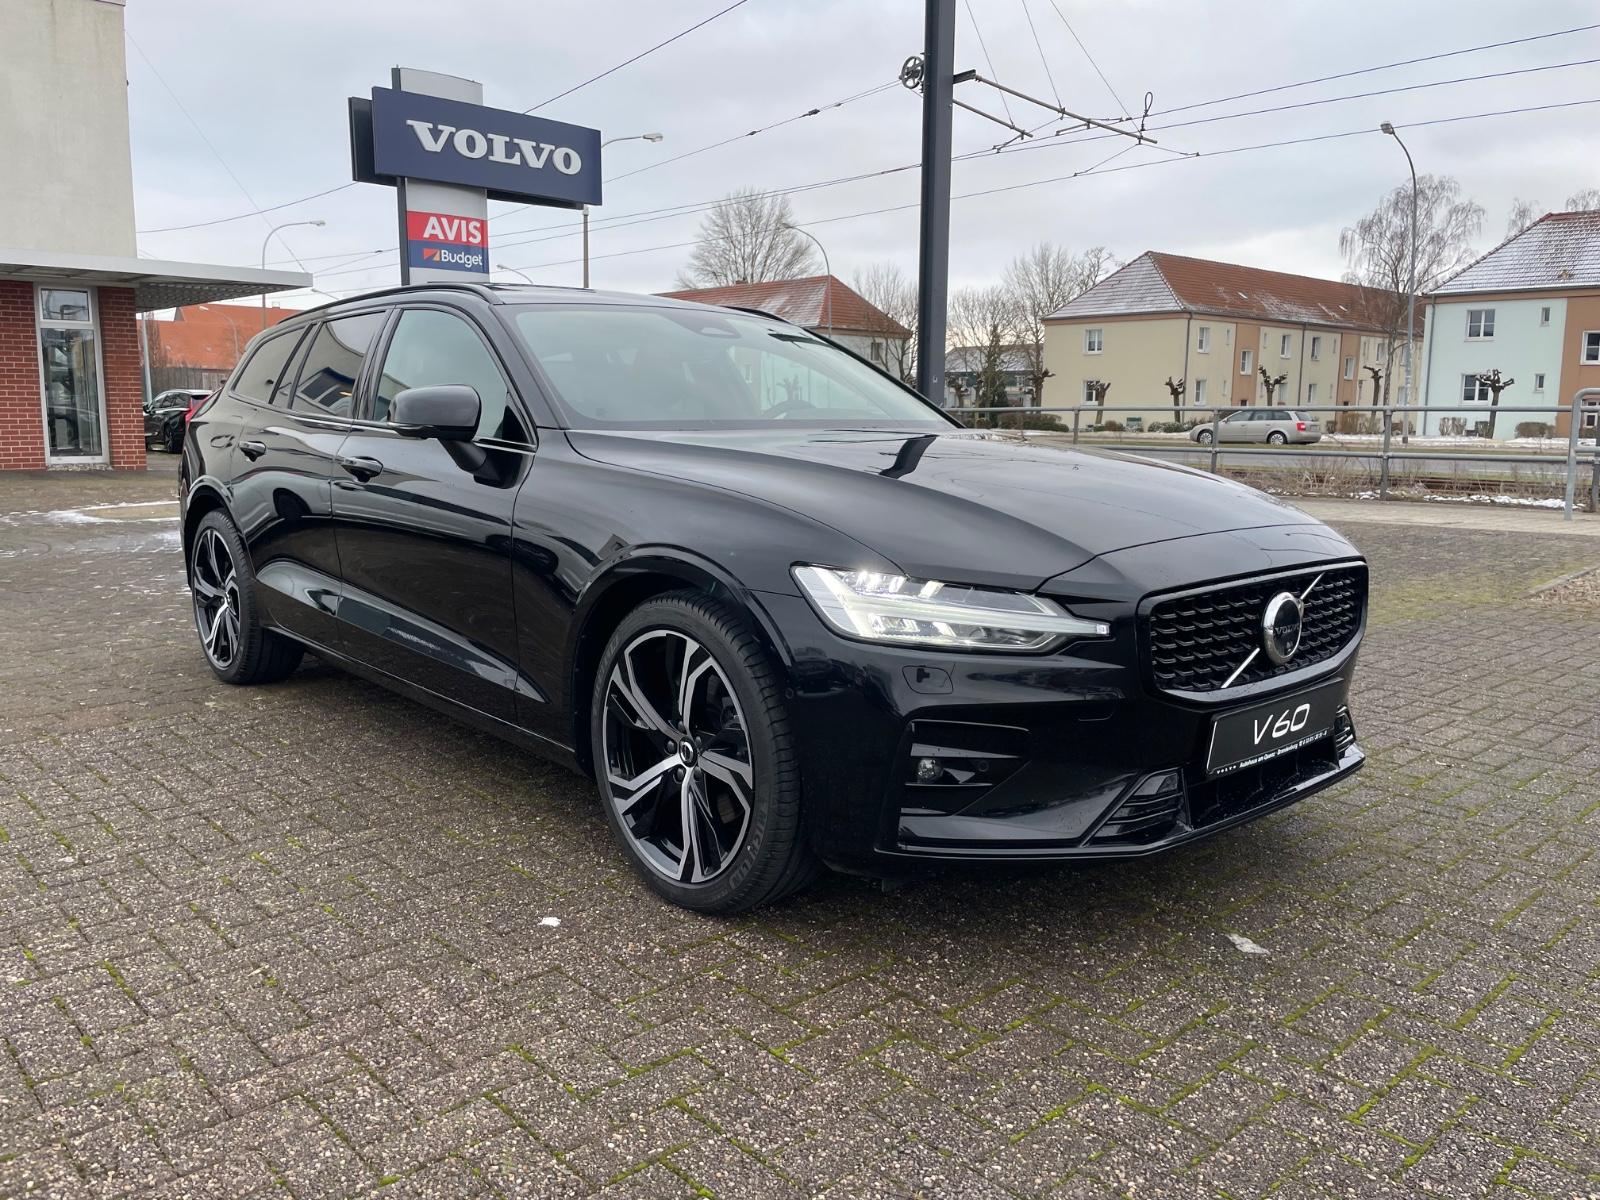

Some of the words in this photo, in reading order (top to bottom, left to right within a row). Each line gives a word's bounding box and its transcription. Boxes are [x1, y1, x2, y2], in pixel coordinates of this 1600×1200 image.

[406, 120, 582, 175] VOLVO
[423, 216, 482, 244] AVIS
[441, 249, 483, 268] Budget
